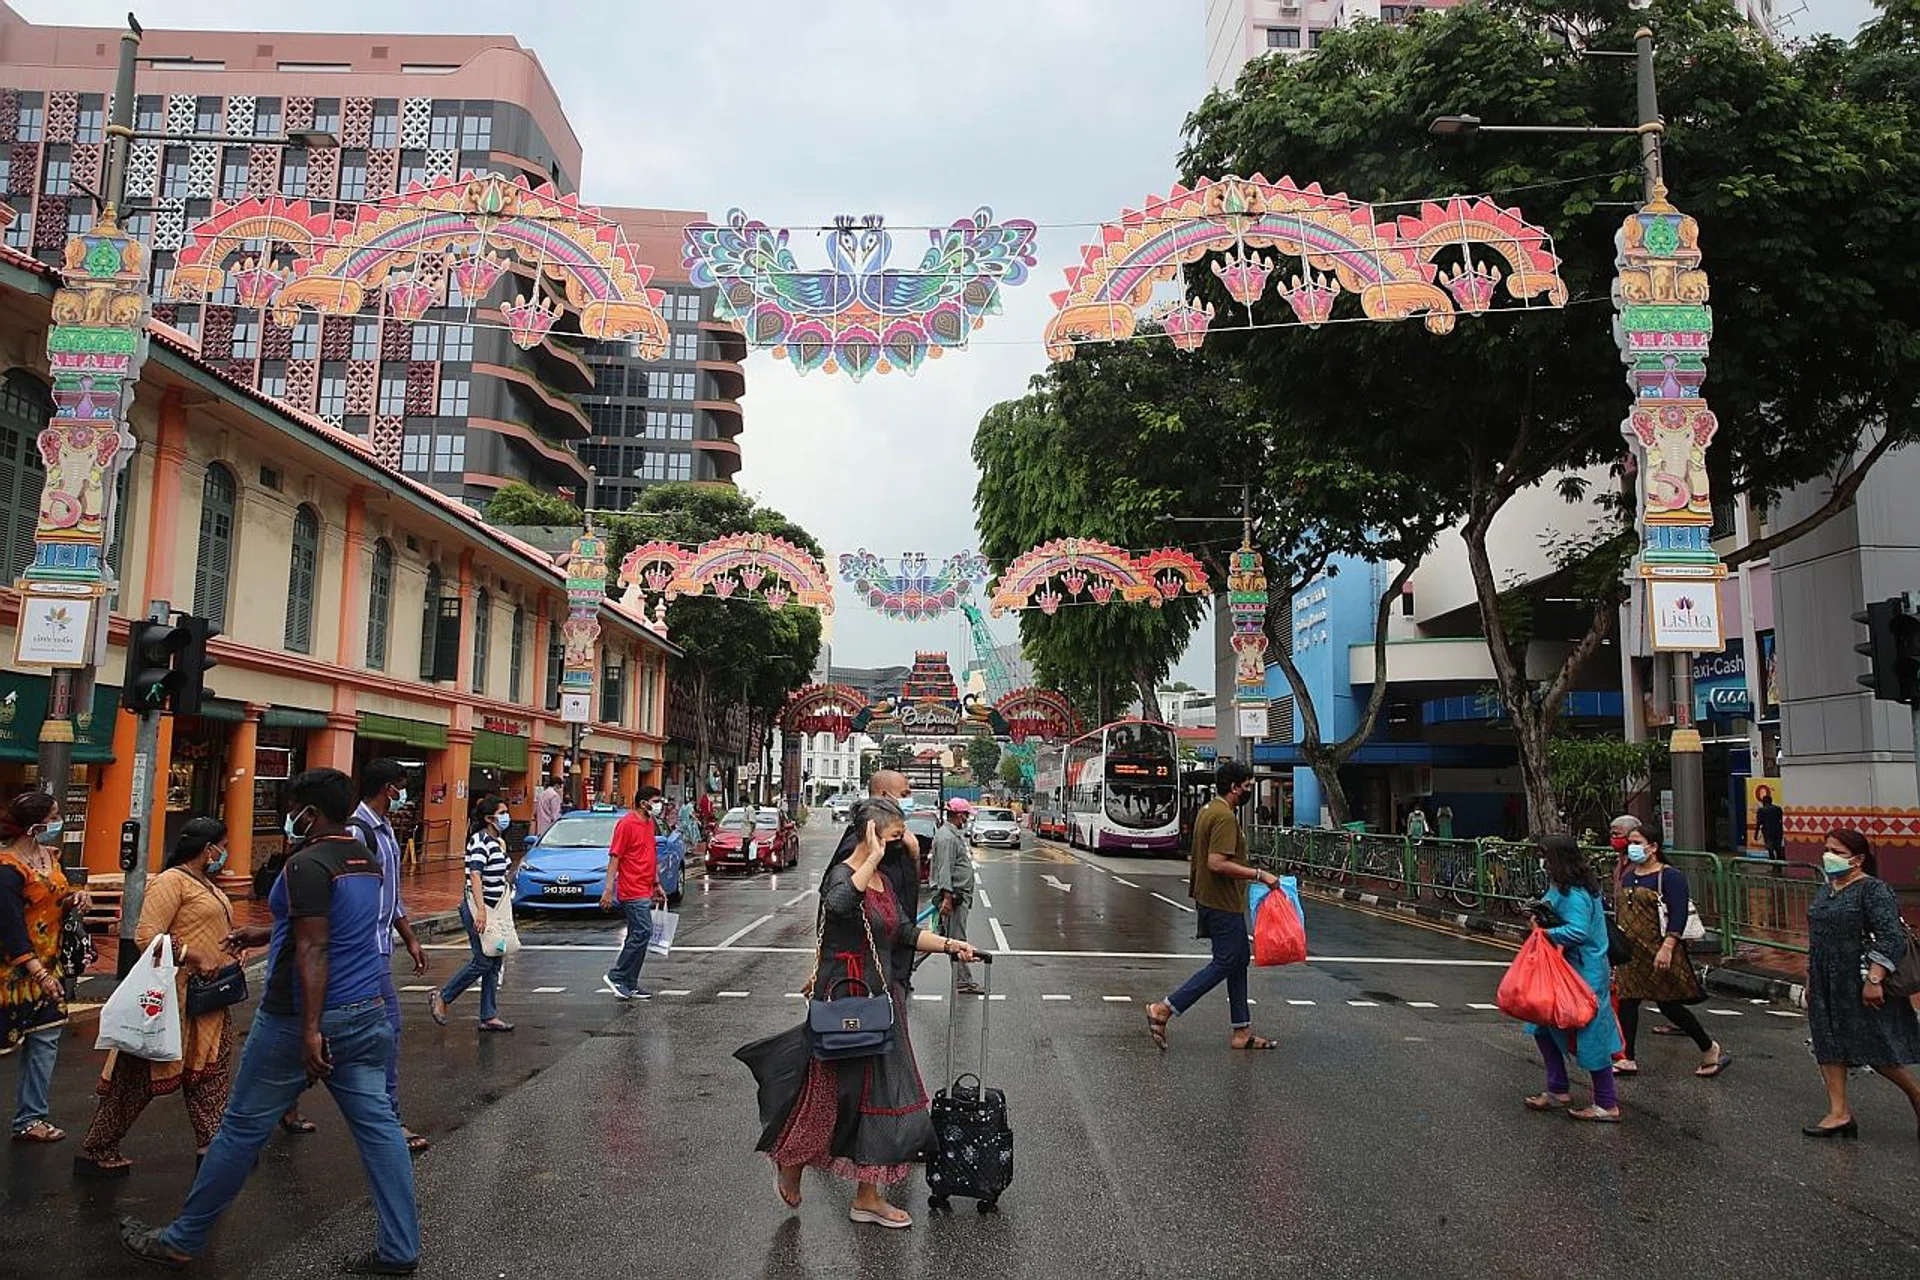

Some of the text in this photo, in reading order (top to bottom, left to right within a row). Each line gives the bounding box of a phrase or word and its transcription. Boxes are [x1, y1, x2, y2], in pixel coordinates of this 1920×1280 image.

[1660, 607, 1712, 629] Lisha
[1693, 654, 1744, 679] axi-Cash
[1717, 691, 1747, 704] 664
[1156, 765, 1169, 776] 23
